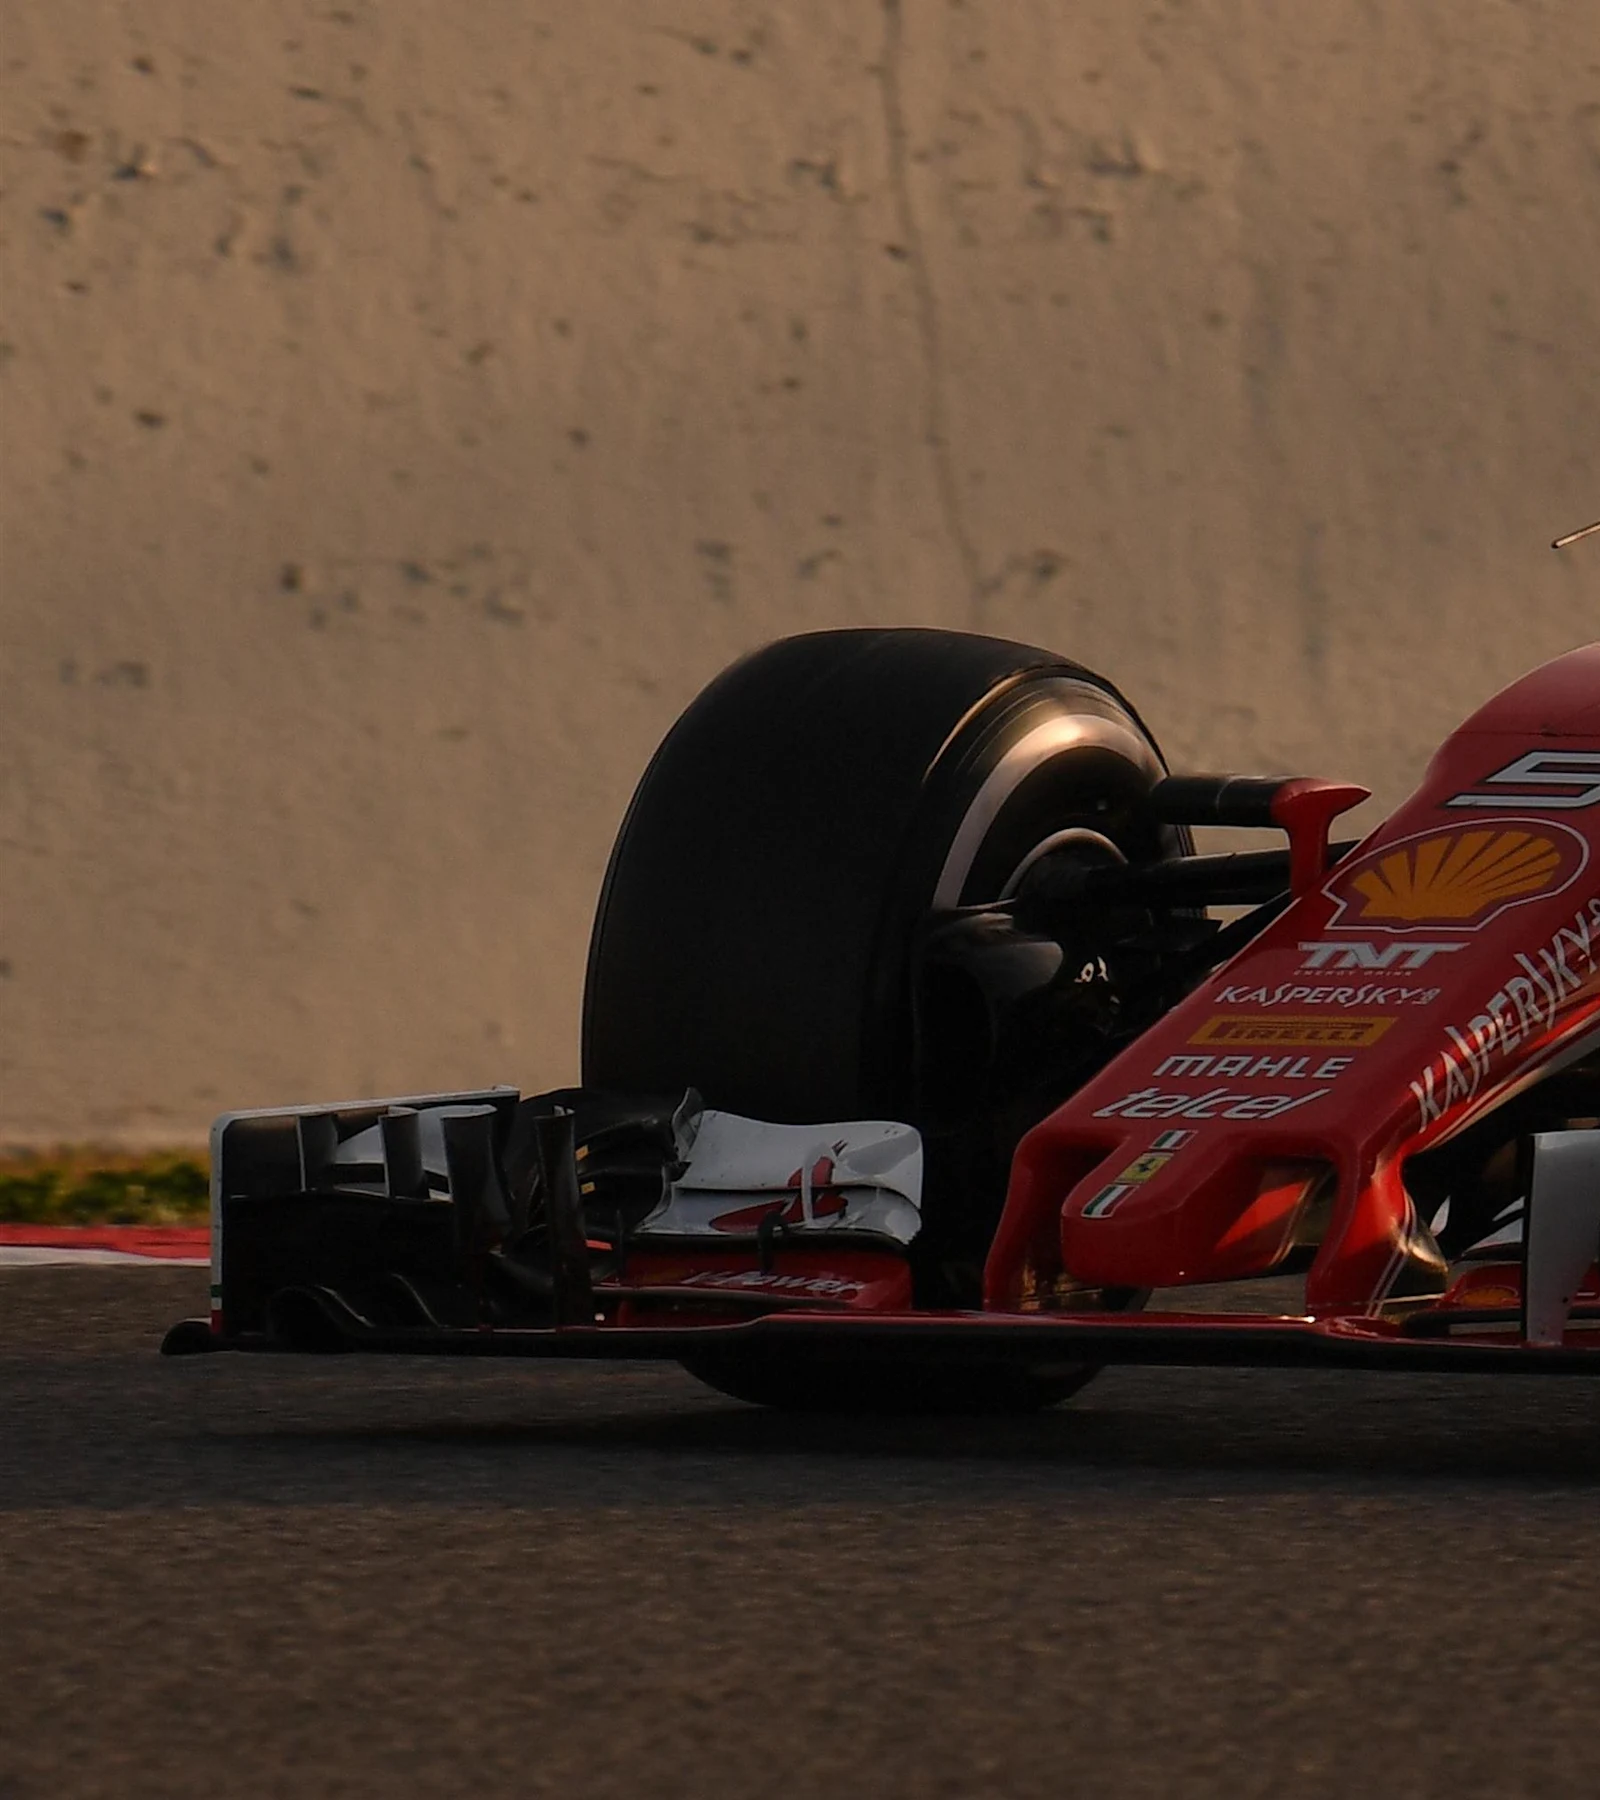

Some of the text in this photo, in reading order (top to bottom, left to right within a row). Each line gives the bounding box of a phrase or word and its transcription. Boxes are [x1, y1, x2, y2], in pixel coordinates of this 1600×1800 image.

[1297, 941, 1471, 970] TNT
[1293, 969, 1358, 977] ENERGY
[1214, 983, 1424, 1008] KASPERSKY
[1208, 1021, 1375, 1041] PIRELLI
[1409, 911, 1597, 1134] KASPERSKY
[1152, 1055, 1355, 1079] MAHLE
[1092, 1087, 1333, 1121] telcel
